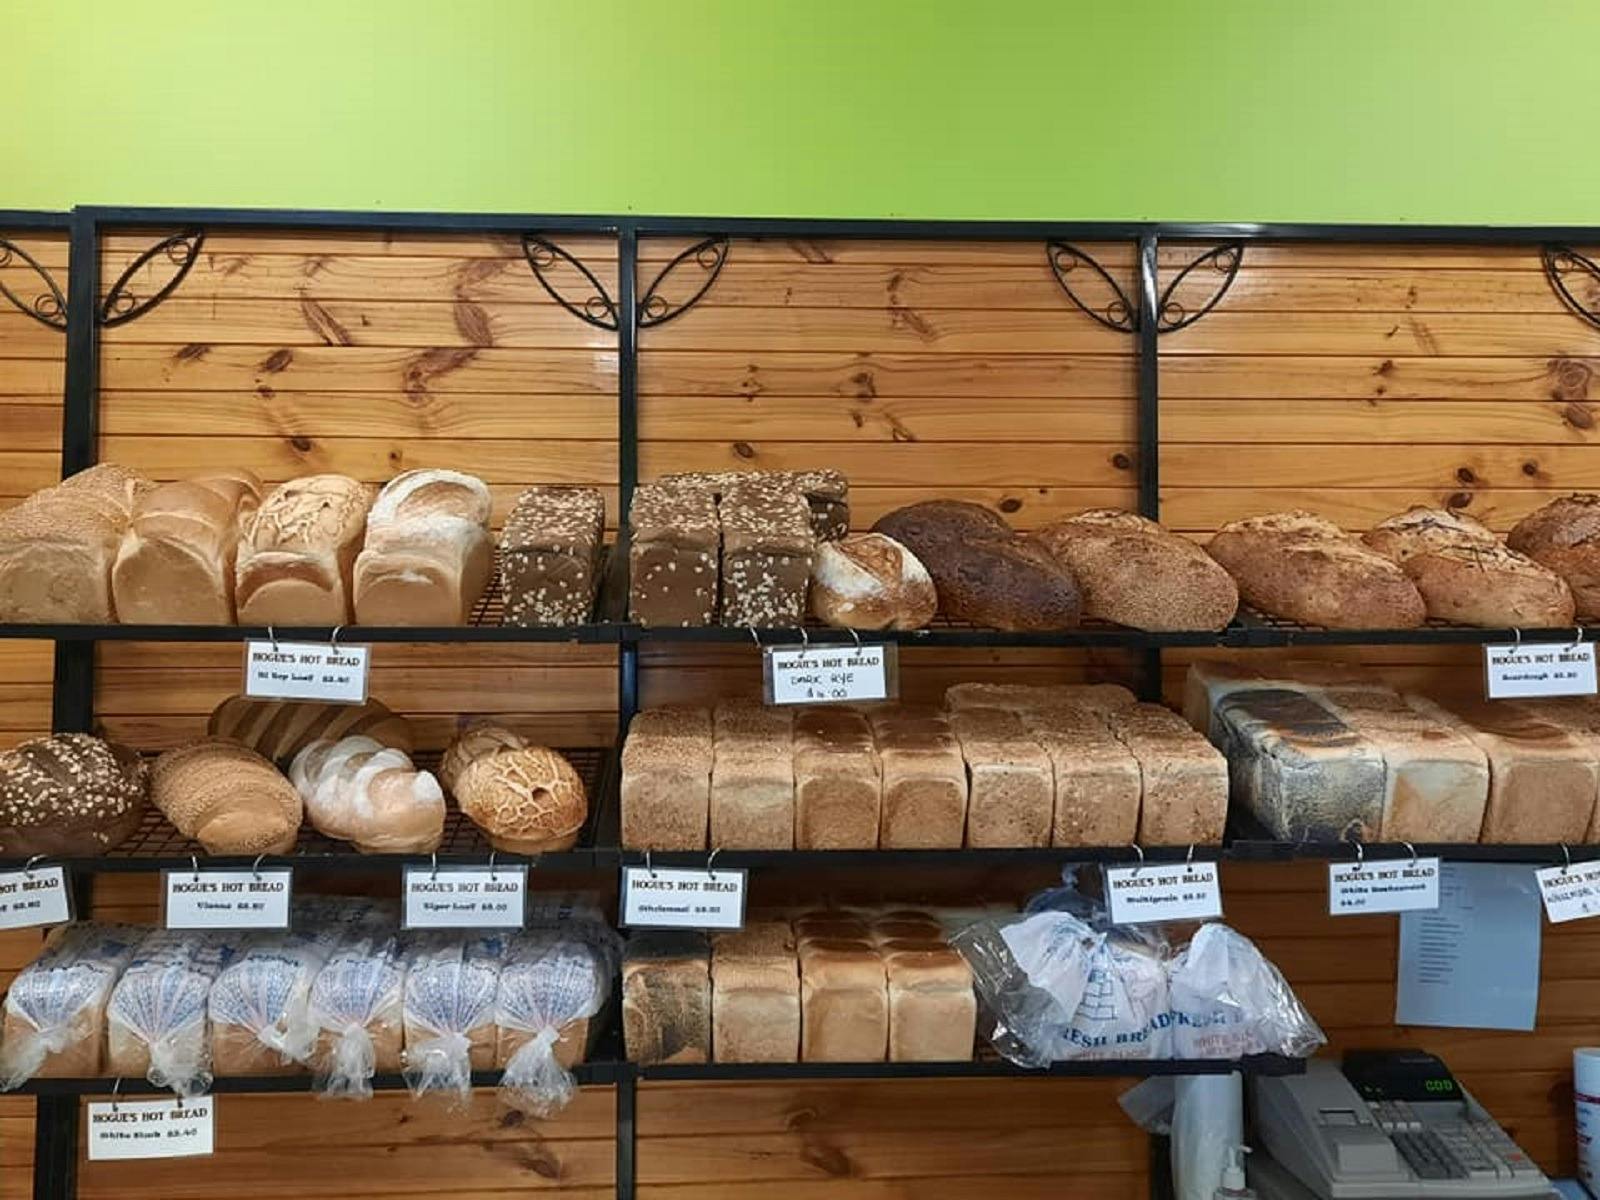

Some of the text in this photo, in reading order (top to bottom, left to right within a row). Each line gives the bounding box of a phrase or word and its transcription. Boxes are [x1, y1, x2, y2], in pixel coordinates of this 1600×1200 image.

[300, 655, 322, 664] HOT
[326, 656, 361, 666] BREAD
[822, 658, 842, 668] HOT
[847, 656, 880, 667] BREAD
[1535, 654, 1554, 663] HOT
[1559, 652, 1590, 663] BREAD
[1157, 875, 1179, 886] HOT
[1182, 872, 1214, 883] BREAD
[1377, 870, 1398, 879] HOT
[1402, 868, 1435, 878] BREAD
[22, 877, 59, 892] BREAD
[222, 882, 244, 892] HOT
[249, 881, 285, 892] BREAD
[457, 882, 480, 893] HOT
[484, 882, 519, 893] BREAD
[677, 881, 699, 891] HOT
[703, 882, 739, 892] BREAD
[142, 1111, 165, 1122] HOT
[170, 1108, 208, 1120] BREAD
